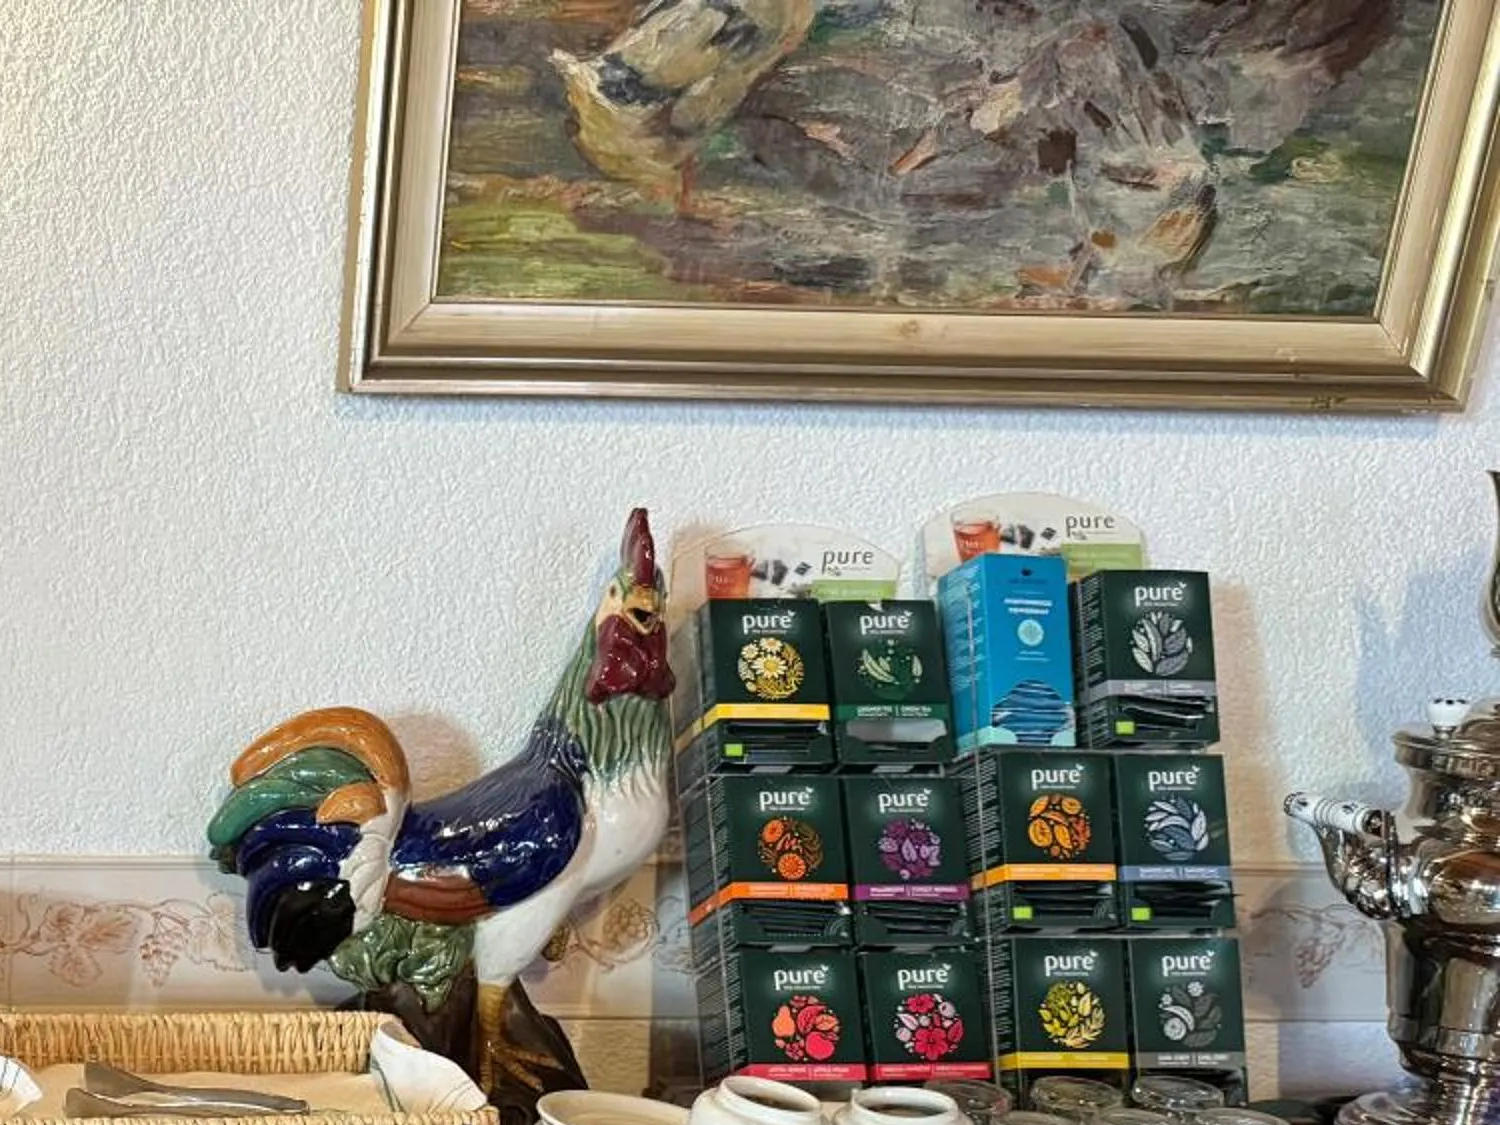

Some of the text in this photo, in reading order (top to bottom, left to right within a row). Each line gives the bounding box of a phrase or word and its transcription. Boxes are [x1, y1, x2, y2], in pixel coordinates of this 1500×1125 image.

[1065, 514, 1116, 538] pure
[822, 548, 874, 574] pure
[1134, 585, 1184, 607] pure
[742, 612, 792, 635] pure
[859, 612, 910, 635] pure
[1031, 766, 1081, 790] pure
[1148, 767, 1198, 791] pure
[759, 789, 811, 812] pure
[878, 791, 929, 814] pure
[1044, 953, 1095, 977] pure
[1161, 953, 1213, 977] pure
[773, 967, 826, 991] pure
[897, 966, 949, 991] pure
